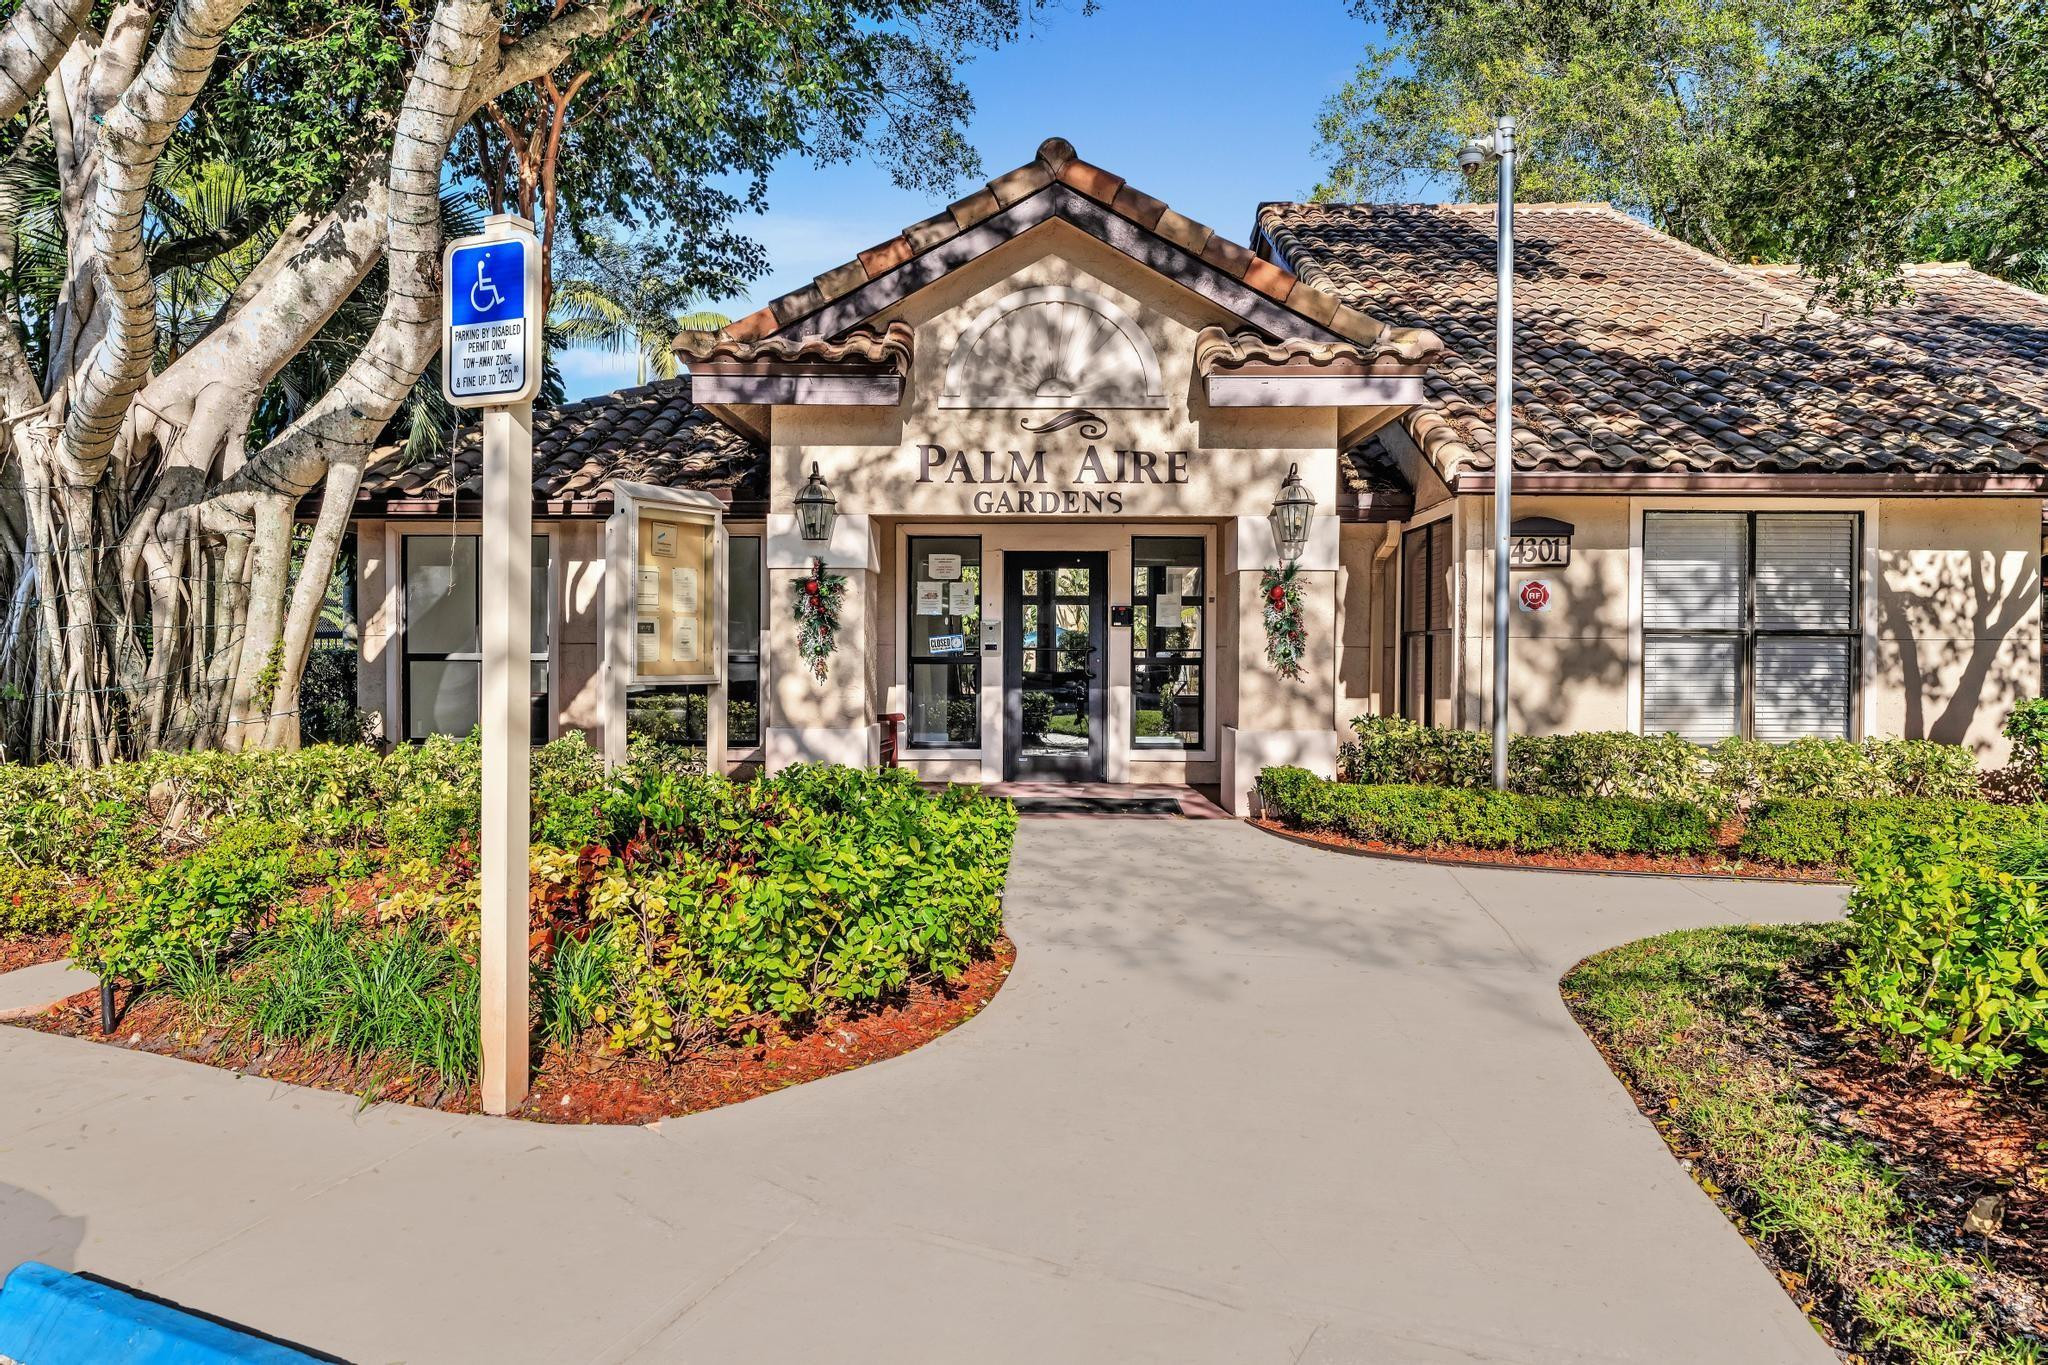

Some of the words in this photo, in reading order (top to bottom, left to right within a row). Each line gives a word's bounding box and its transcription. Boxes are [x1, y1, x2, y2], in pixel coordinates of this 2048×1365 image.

[455, 328, 480, 341] PARKING
[482, 327, 490, 338] BY
[492, 324, 521, 338] DISABLED
[468, 340, 490, 353] PERMIT
[492, 339, 507, 351] ONLY
[463, 356, 494, 369] TOW-AWAY
[495, 353, 512, 366] ZONE
[456, 377, 461, 388] &
[463, 376, 476, 387] FINE
[915, 443, 1048, 484] PALM
[1072, 444, 1189, 484] AIRE
[973, 490, 1123, 514] GARDENS
[1511, 537, 1562, 566] 4301
[1528, 592, 1541, 600] RF
[930, 638, 951, 648] CLOSED
